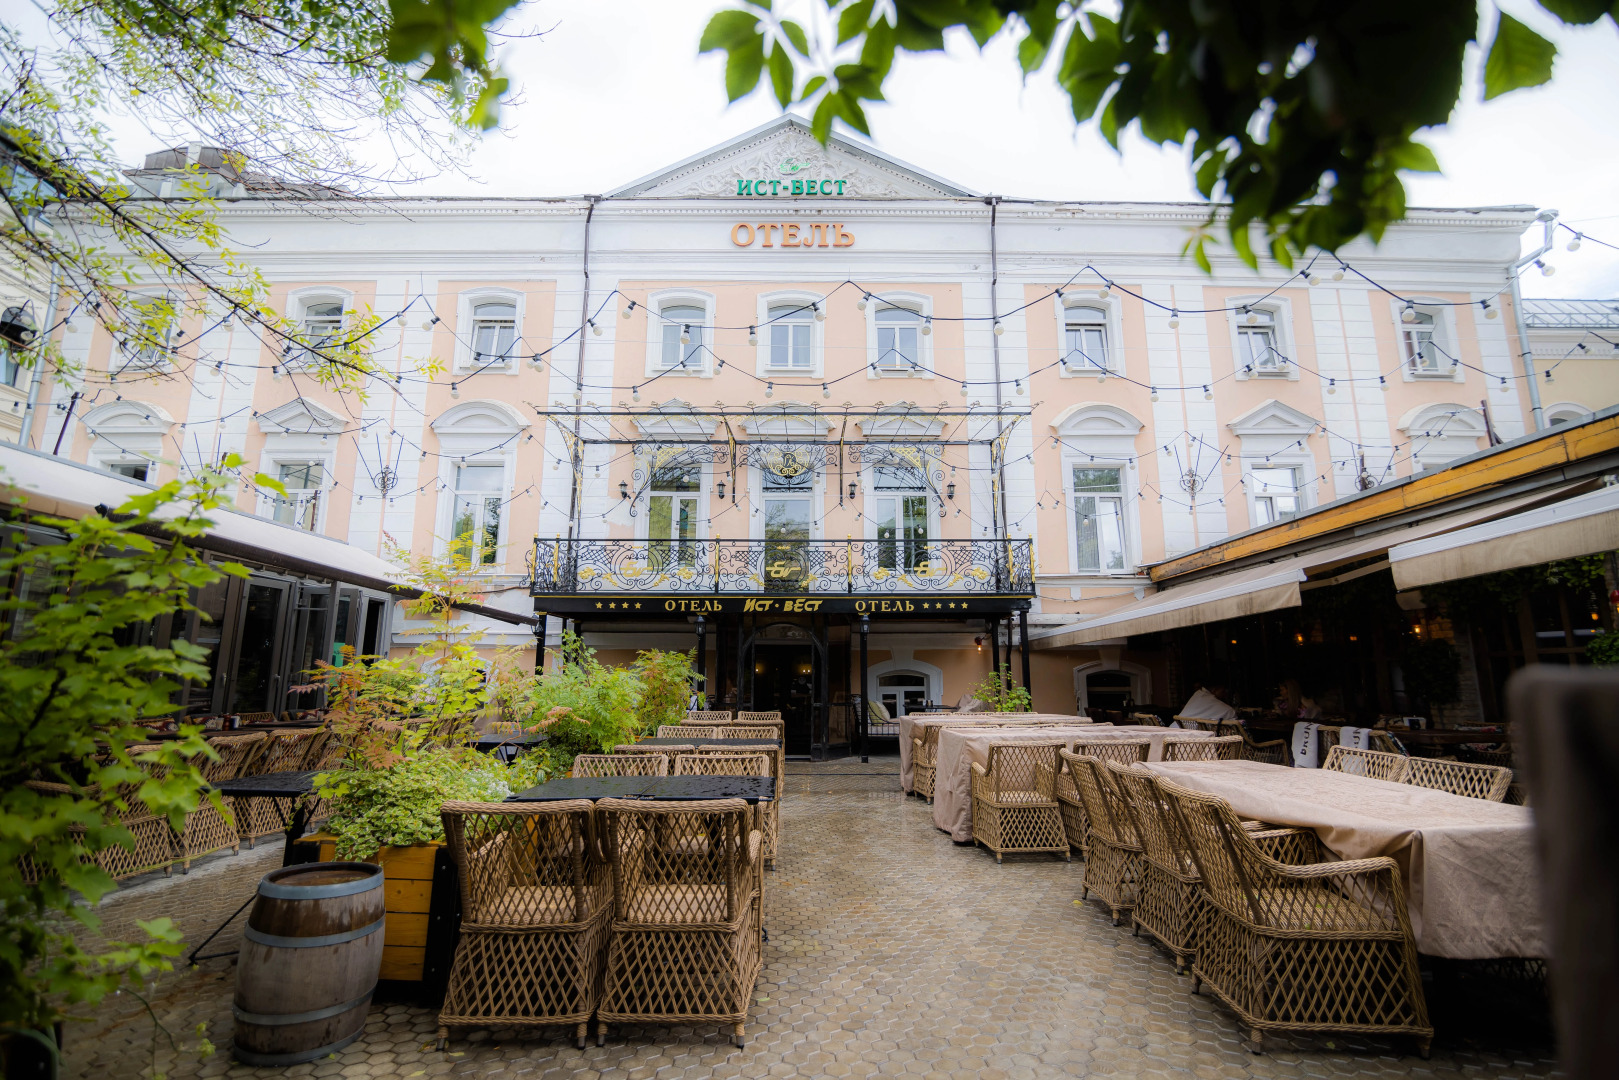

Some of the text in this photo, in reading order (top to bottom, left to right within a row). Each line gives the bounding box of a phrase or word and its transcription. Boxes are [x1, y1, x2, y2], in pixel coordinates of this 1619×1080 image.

[736, 179, 847, 196] ИСТ-ВЕСТ
[731, 222, 855, 247] ОТЕЛЬ
[664, 598, 915, 613] ОТЕЛЬ ИСТ ВЕСТ ОТЕЛЬ
